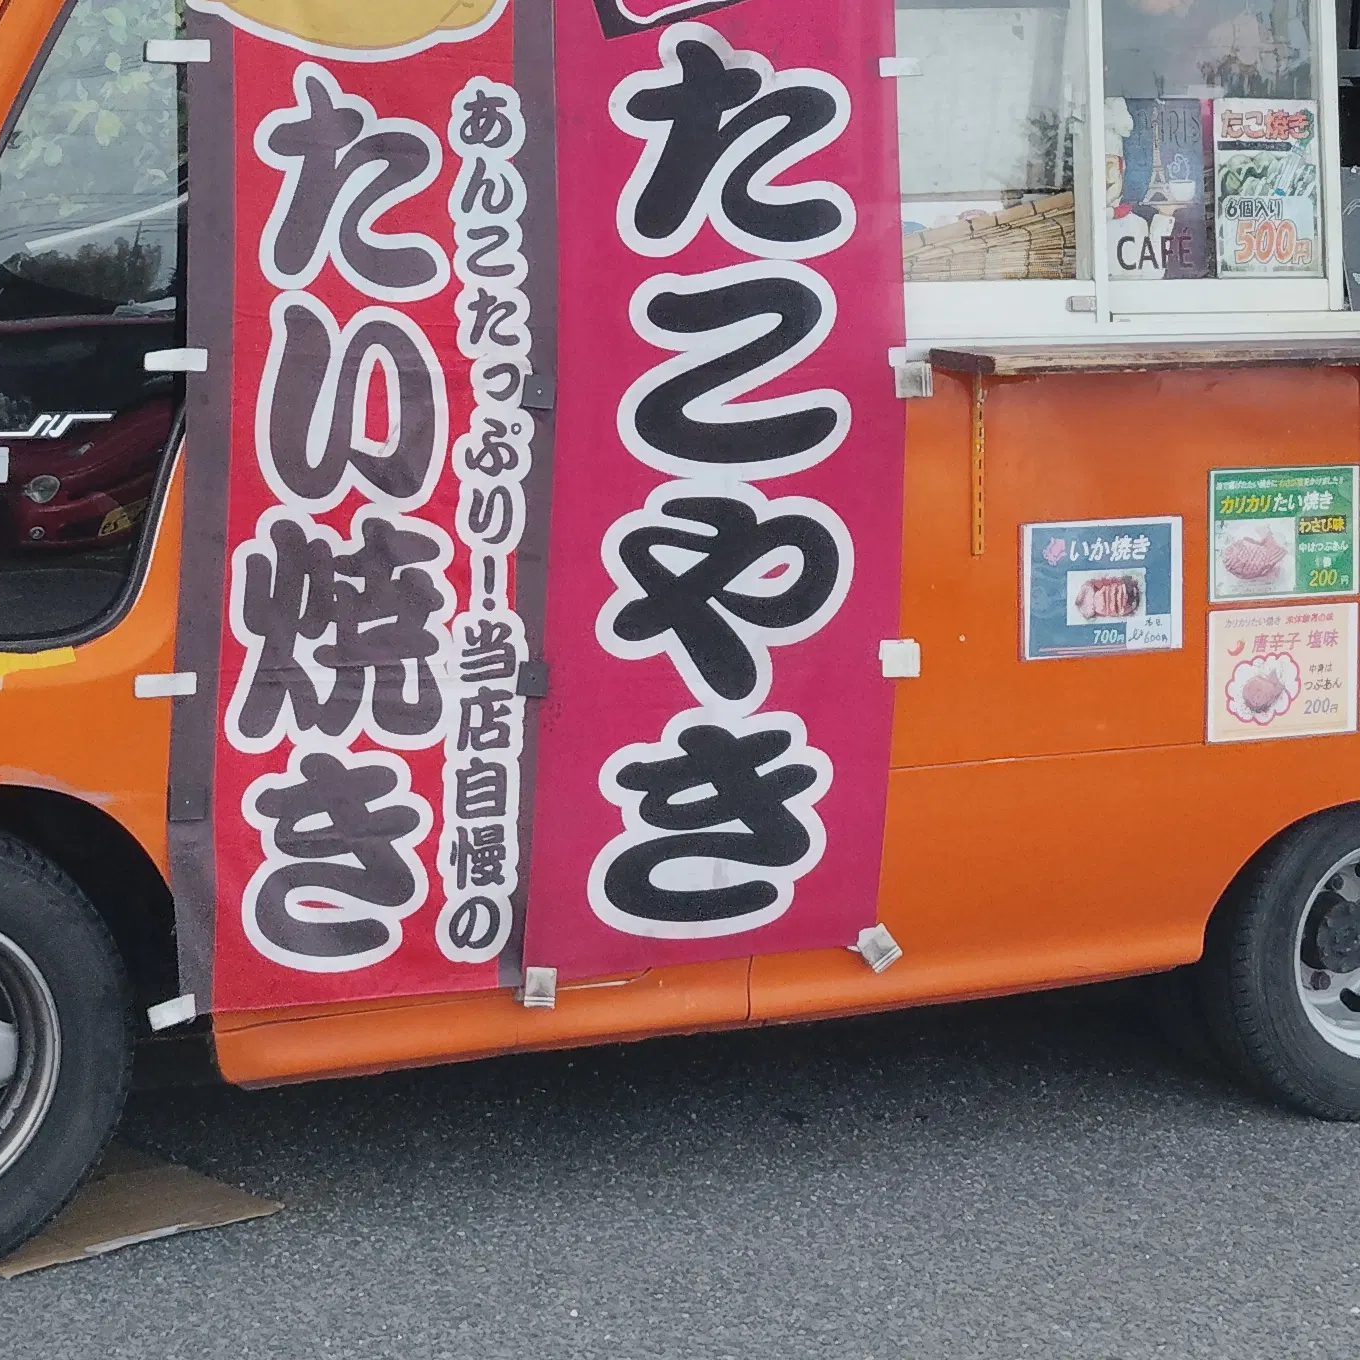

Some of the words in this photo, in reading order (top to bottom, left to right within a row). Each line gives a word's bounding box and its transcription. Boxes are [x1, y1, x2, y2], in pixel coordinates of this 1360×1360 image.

[1220, 108, 1313, 140] たこ焼き
[1224, 197, 1283, 220] 6個入り
[1116, 227, 1193, 270] CAFÉ
[1234, 219, 1313, 265] 500円
[586, 22, 858, 940] たこやき
[226, 58, 448, 972] たい焼き
[1219, 490, 1334, 515] カリカリたい焼き
[1069, 534, 1152, 562] いか焼き
[1251, 632, 1301, 653] 唐辛子
[1306, 629, 1339, 649] 塩味
